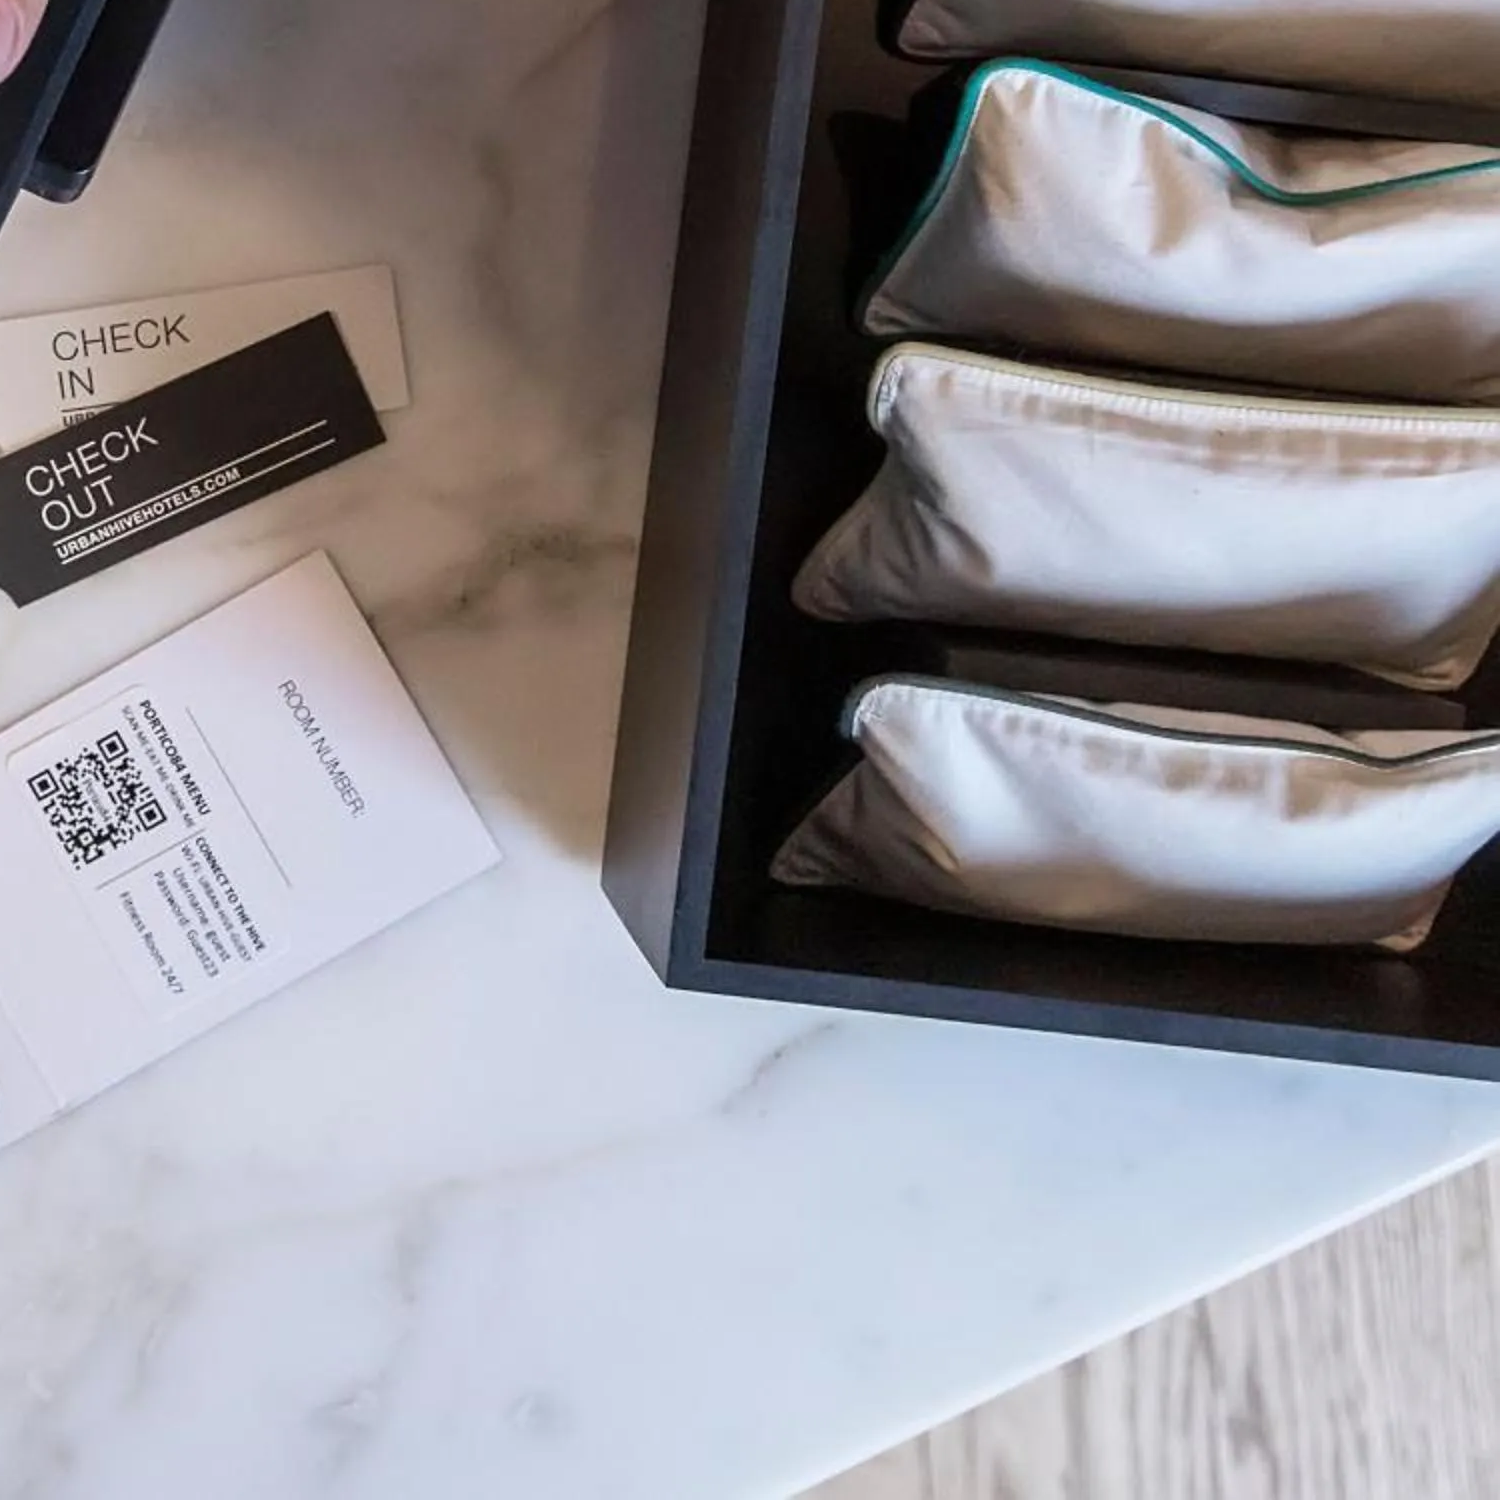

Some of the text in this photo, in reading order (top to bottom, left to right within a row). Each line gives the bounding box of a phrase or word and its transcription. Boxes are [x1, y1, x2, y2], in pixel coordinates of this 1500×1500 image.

[50, 312, 190, 363] CHECK
[57, 366, 95, 399] IN
[21, 415, 159, 500] CHECK
[36, 473, 123, 535] OUT
[55, 466, 242, 560] URBANHIVEHOTELS.COM
[137, 698, 212, 817] PORTICO84 MENU
[277, 678, 368, 819] ROOM NUMBER:
[194, 835, 266, 952] CONNECT TO THE HIVE
[117, 890, 185, 996] Fitness Room 24/7
[203, 928, 231, 964] guest
